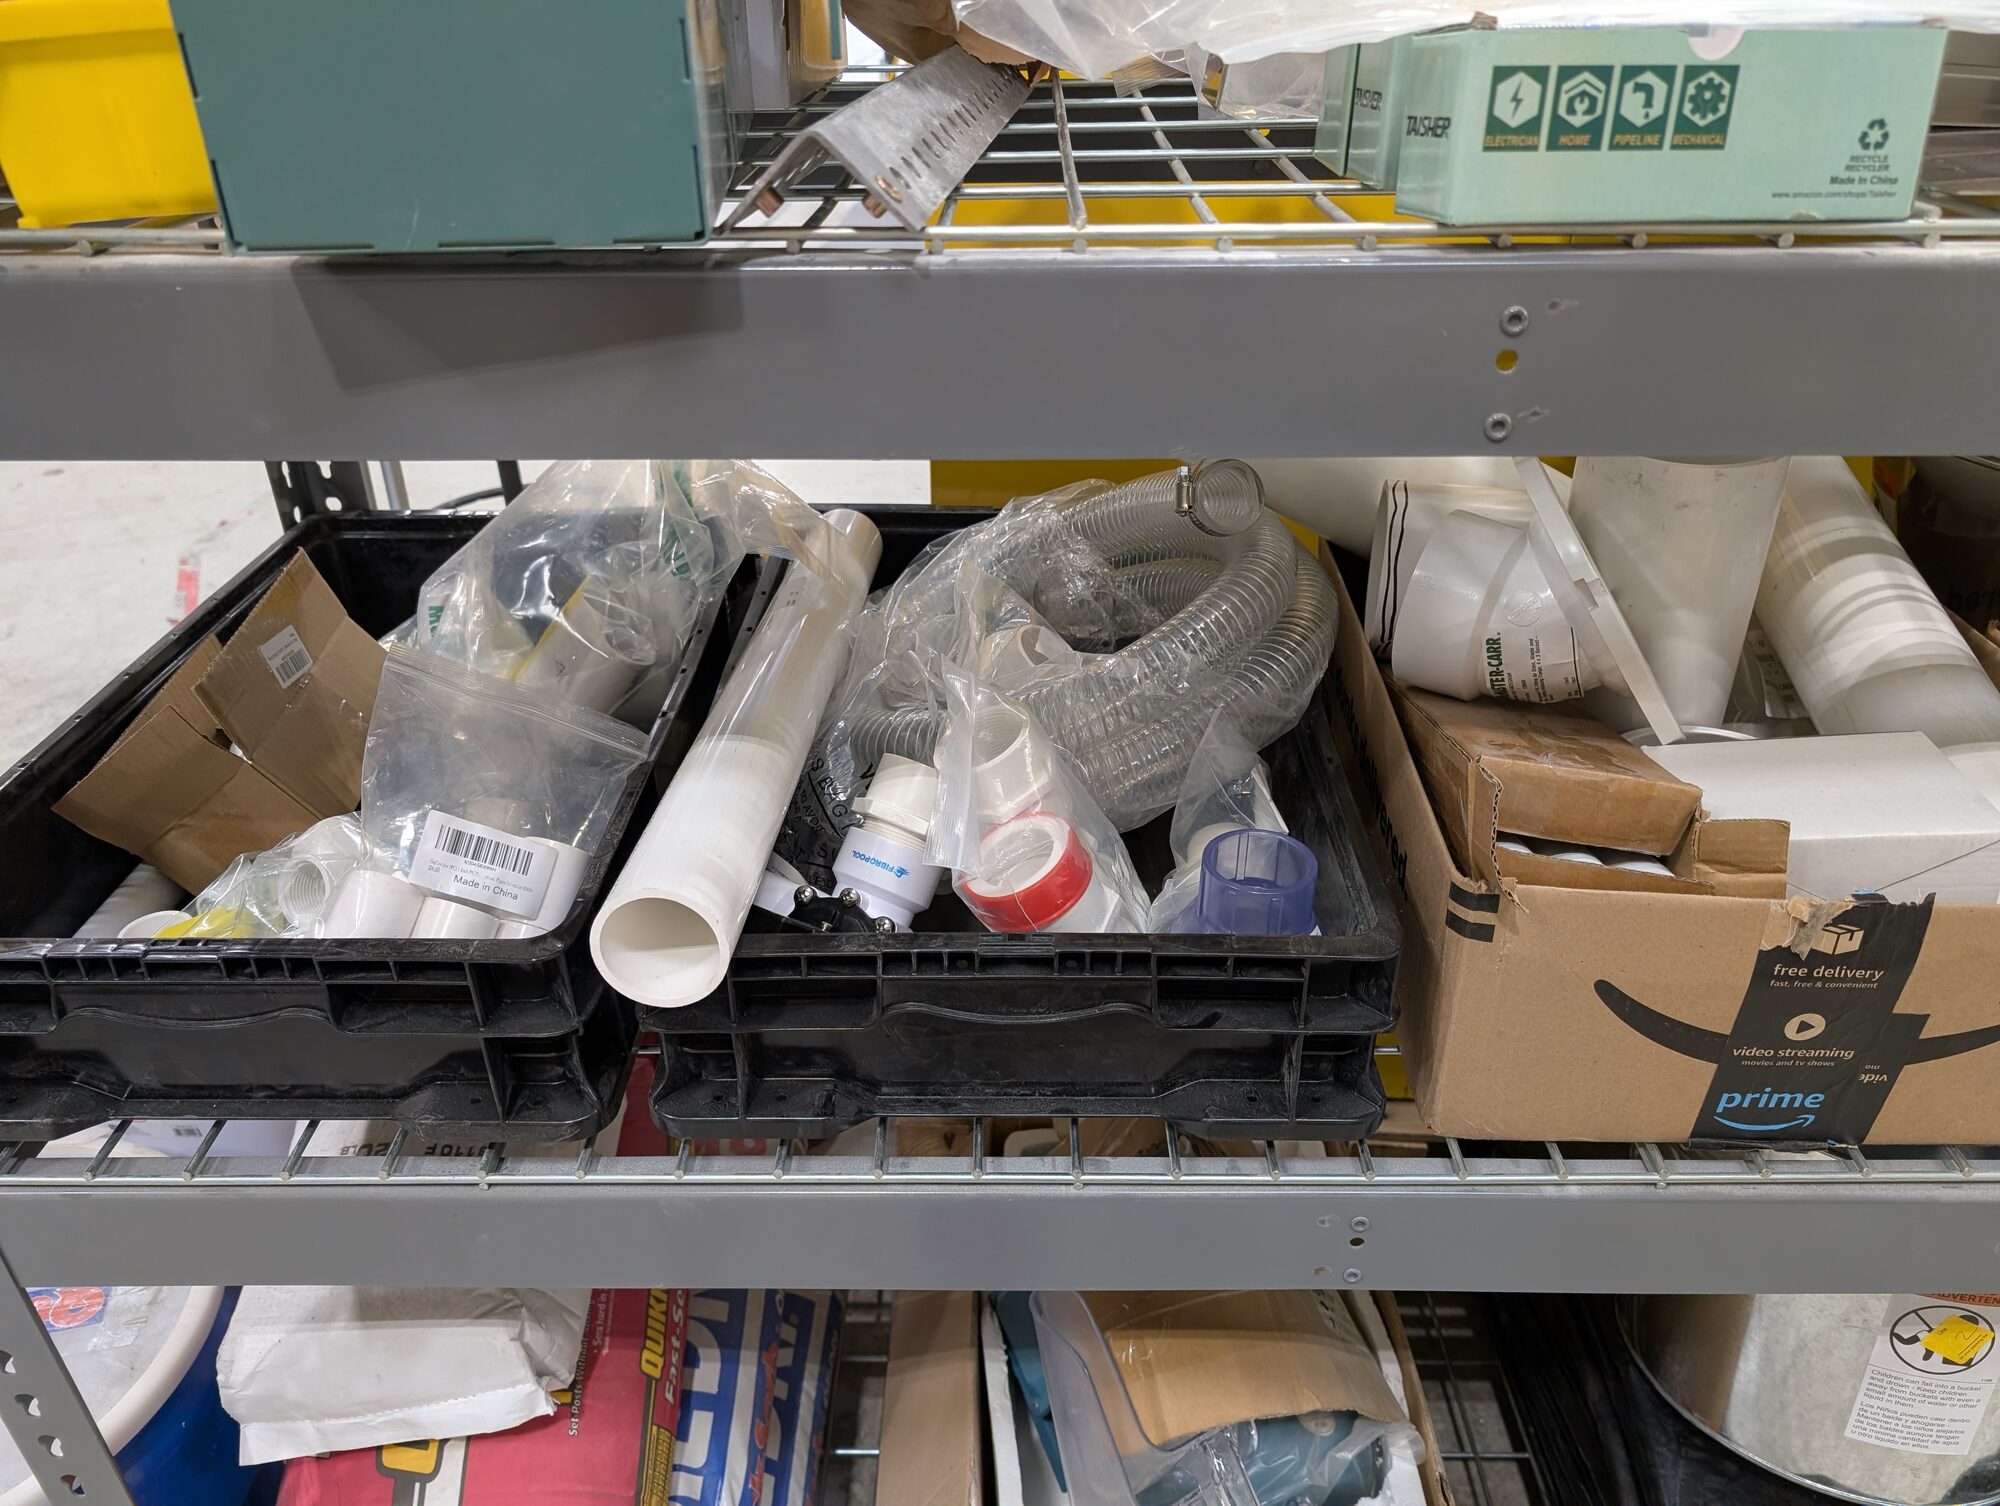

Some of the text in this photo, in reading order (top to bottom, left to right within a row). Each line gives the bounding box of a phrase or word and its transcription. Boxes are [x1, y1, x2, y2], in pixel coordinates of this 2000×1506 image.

[1406, 115, 1452, 139] TAISHER
[1484, 135, 1540, 147] ELECTRICIAN
[1558, 135, 1592, 146] HOME
[1612, 134, 1661, 146] PIPELINE
[1672, 134, 1725, 146] MECHANICAL
[1849, 155, 1889, 163] RECYCLE
[1844, 164, 1890, 172] RECYCLER
[1829, 175, 1856, 185] Made
[1869, 175, 1899, 185] China
[852, 850, 895, 874] FIBROPOOL
[453, 875, 480, 889] Made
[482, 882, 491, 892] in
[492, 886, 519, 901] China
[1773, 963, 1885, 981] free delivery
[1770, 980, 1790, 988] fast,
[1794, 980, 1813, 988] free
[1825, 981, 1878, 989] convenient
[1732, 1046, 1855, 1060] video streaming
[1741, 1059, 1774, 1067] movies
[1795, 1059, 1805, 1067] tv
[1716, 1087, 1825, 1113] prime
[593, 1293, 607, 1345] Sets hard in
[1872, 1370, 1904, 1382] Children
[1867, 1382, 1888, 1390] away
[1890, 1386, 1907, 1394] from
[1909, 1391, 1938, 1400] buckets
[1869, 1375, 1884, 1383] and
[1886, 1380, 1909, 1389] drown
[1916, 1386, 1937, 1394] Keep
[571, 1384, 583, 1413] Posts
[1864, 1392, 1884, 1402] liquid
[1865, 1387, 1885, 1395] small
[1887, 1394, 1916, 1403] amount
[1856, 1412, 1892, 1424] Mantener
[1860, 1401, 1874, 1409] Los
[1900, 1412, 1928, 1420] pueden
[568, 1418, 579, 1436] Set
[1881, 1411, 1903, 1421] balde
[1911, 1419, 1945, 1428] ahogarse
[1852, 1424, 1867, 1432] una
[1898, 1434, 1929, 1444] cantidad
[1858, 1432, 1872, 1440] otro
[1879, 1424, 1904, 1434] baldes
[1906, 1430, 1933, 1439] aunque
